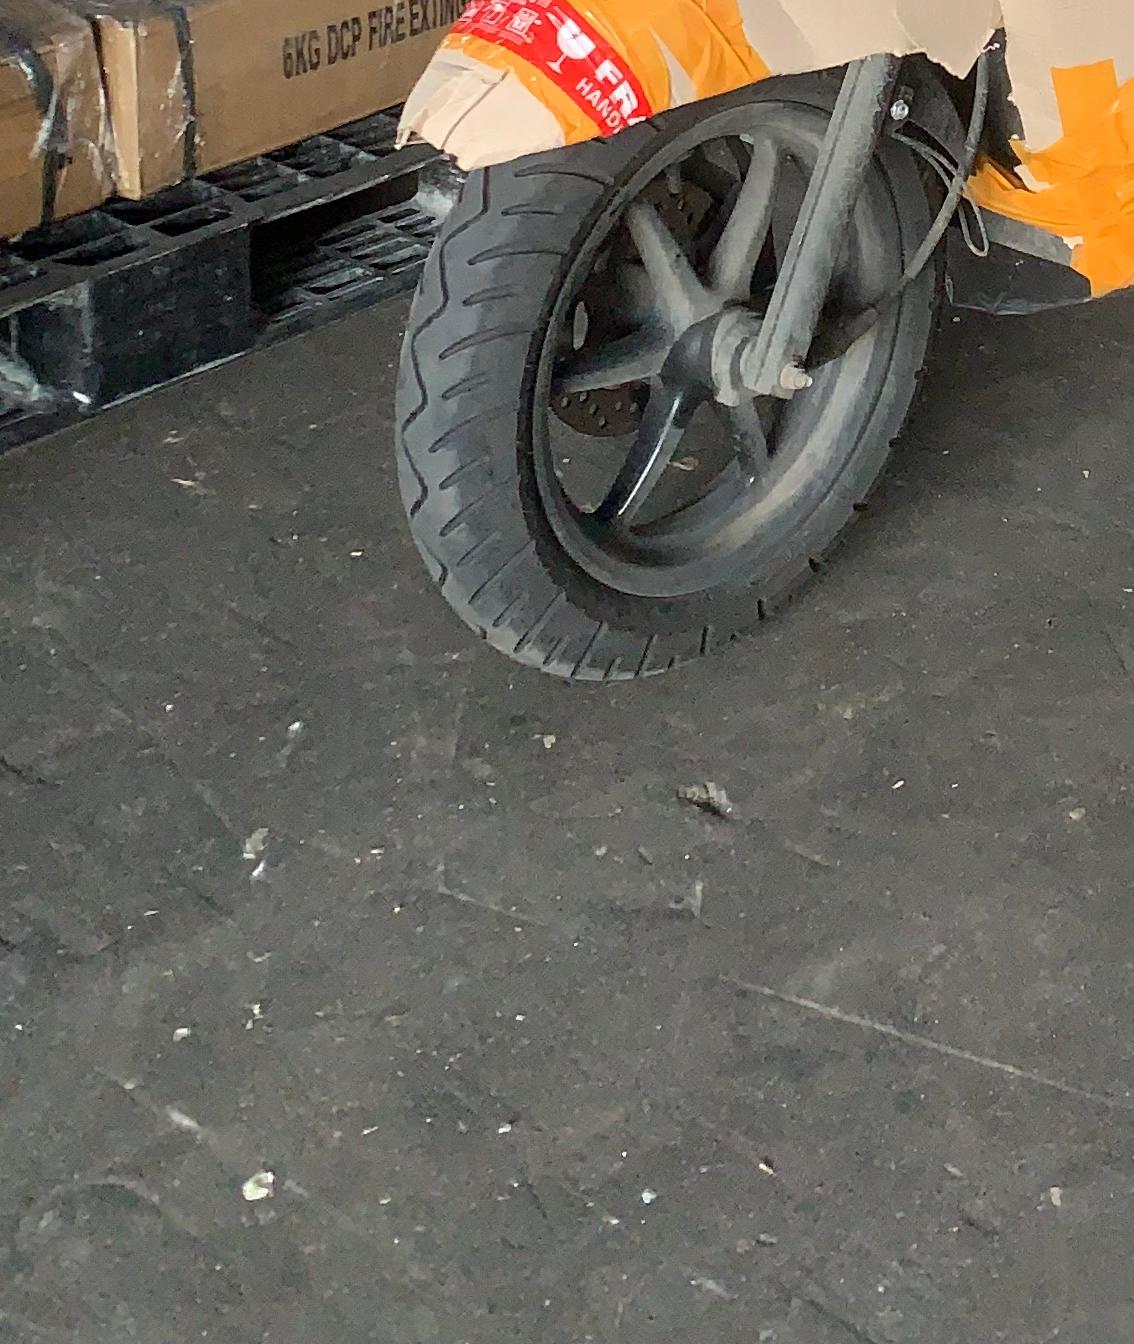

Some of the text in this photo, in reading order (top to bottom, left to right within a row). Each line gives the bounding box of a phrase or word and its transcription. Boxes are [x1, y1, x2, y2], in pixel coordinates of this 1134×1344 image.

[282, 30, 321, 80] 6KG
[326, 16, 363, 66] DCP
[368, 2, 406, 51] FIRE
